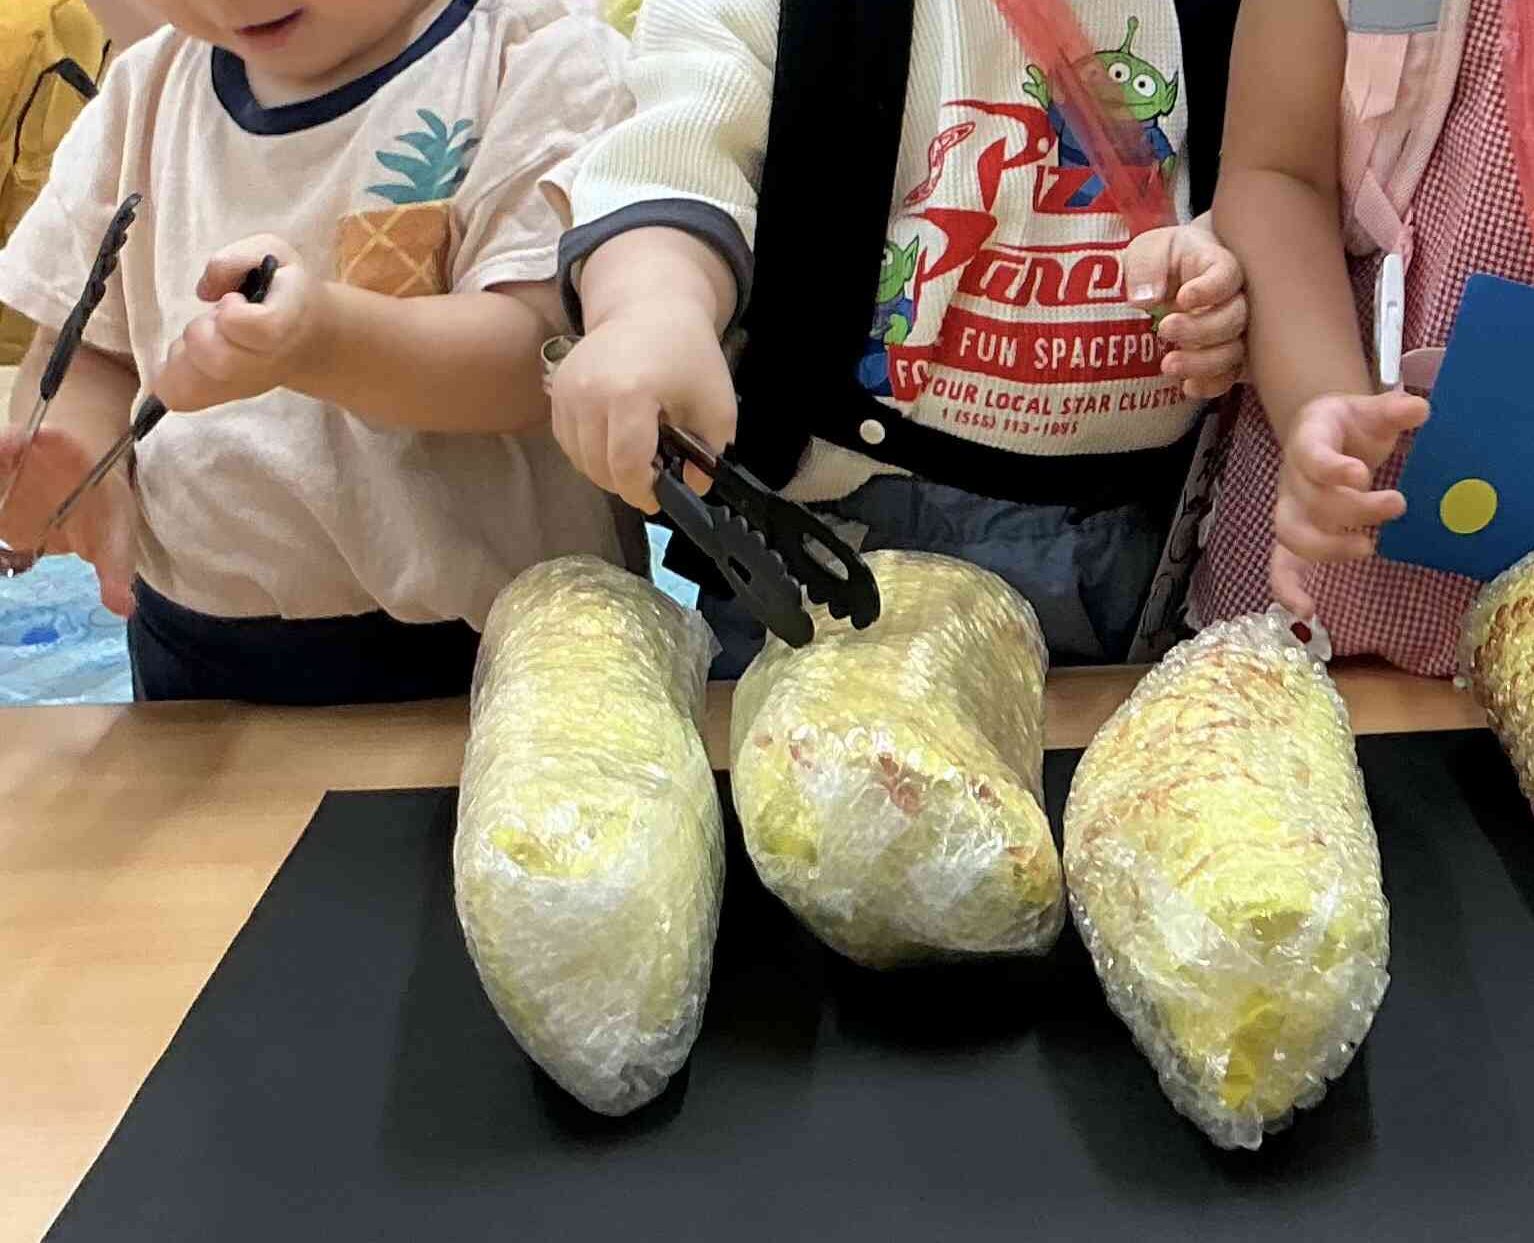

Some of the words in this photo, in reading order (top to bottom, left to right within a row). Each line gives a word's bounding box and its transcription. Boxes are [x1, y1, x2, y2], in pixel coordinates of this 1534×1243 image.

[958, 326, 1018, 369] FUN
[984, 388, 1053, 416] LOCAL
[1060, 394, 1111, 415] STAR
